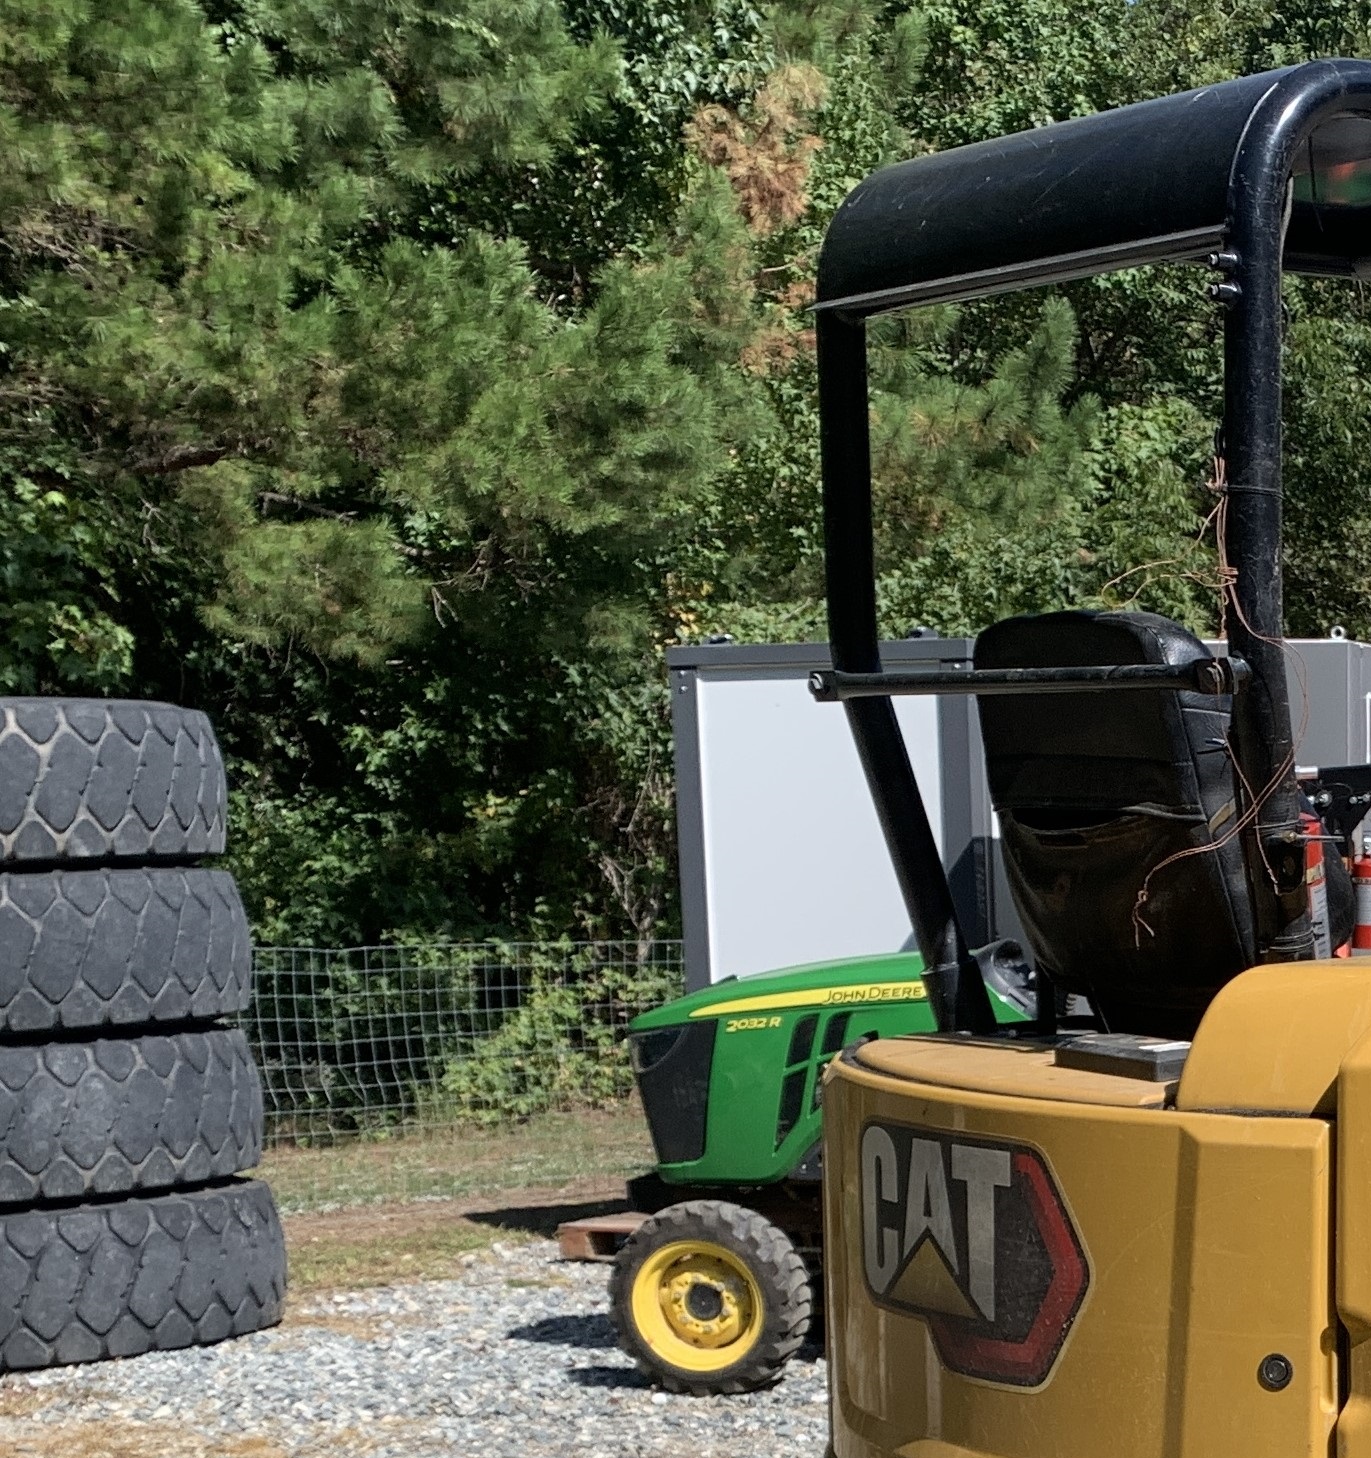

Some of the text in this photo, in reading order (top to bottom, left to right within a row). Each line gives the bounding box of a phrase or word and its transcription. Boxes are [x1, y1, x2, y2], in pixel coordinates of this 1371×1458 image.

[824, 986, 923, 1004] JOHN DEERE
[862, 1126, 1011, 1322] CAT
